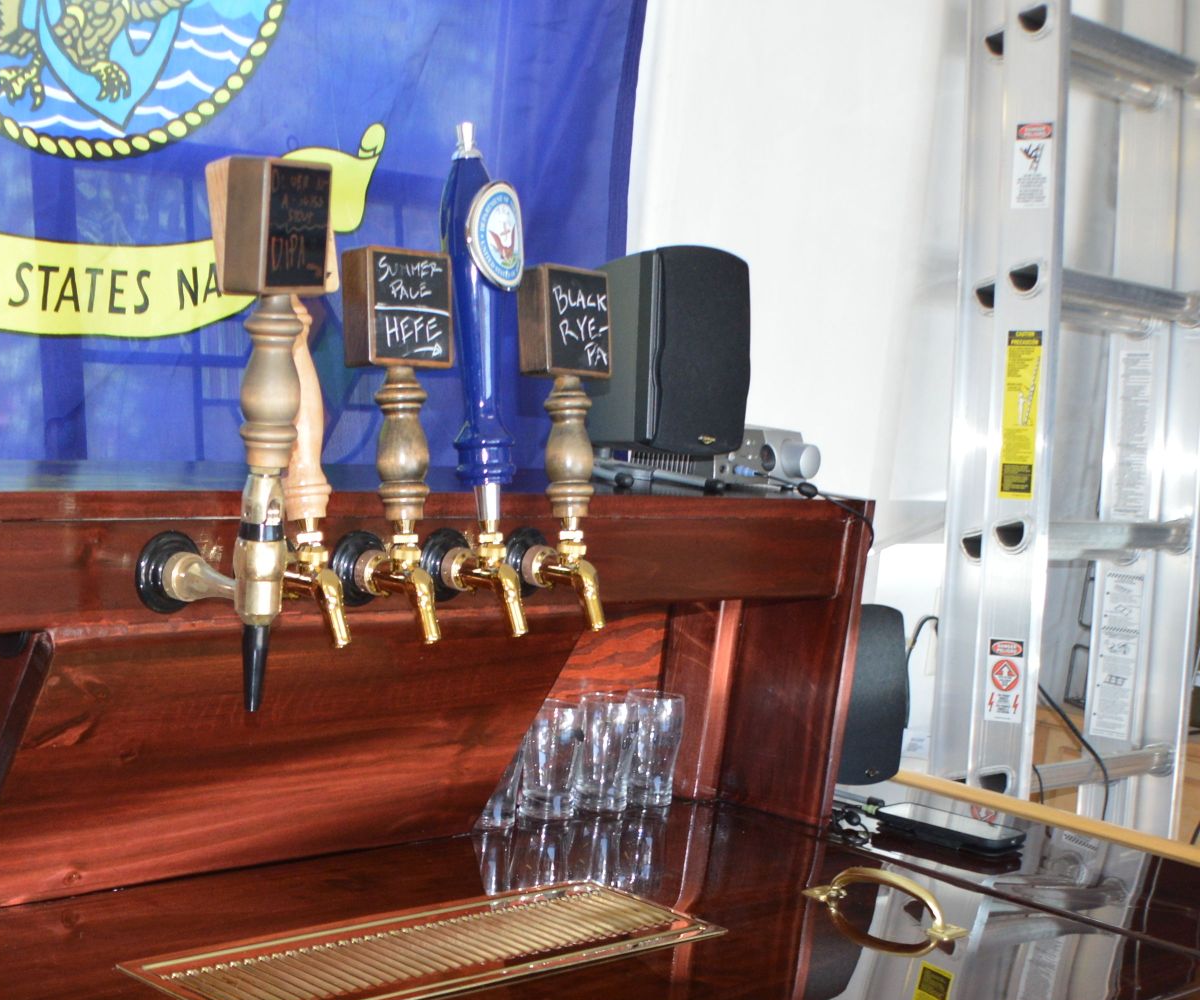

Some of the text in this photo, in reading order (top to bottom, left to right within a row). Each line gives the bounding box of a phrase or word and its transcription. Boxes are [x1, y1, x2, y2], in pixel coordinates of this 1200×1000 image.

[270, 233, 306, 272] DIPA
[8, 261, 151, 315] STATES
[176, 265, 224, 311] NA
[389, 279, 432, 301] PALE
[552, 285, 608, 315] BLACK
[385, 315, 443, 348] HEFE
